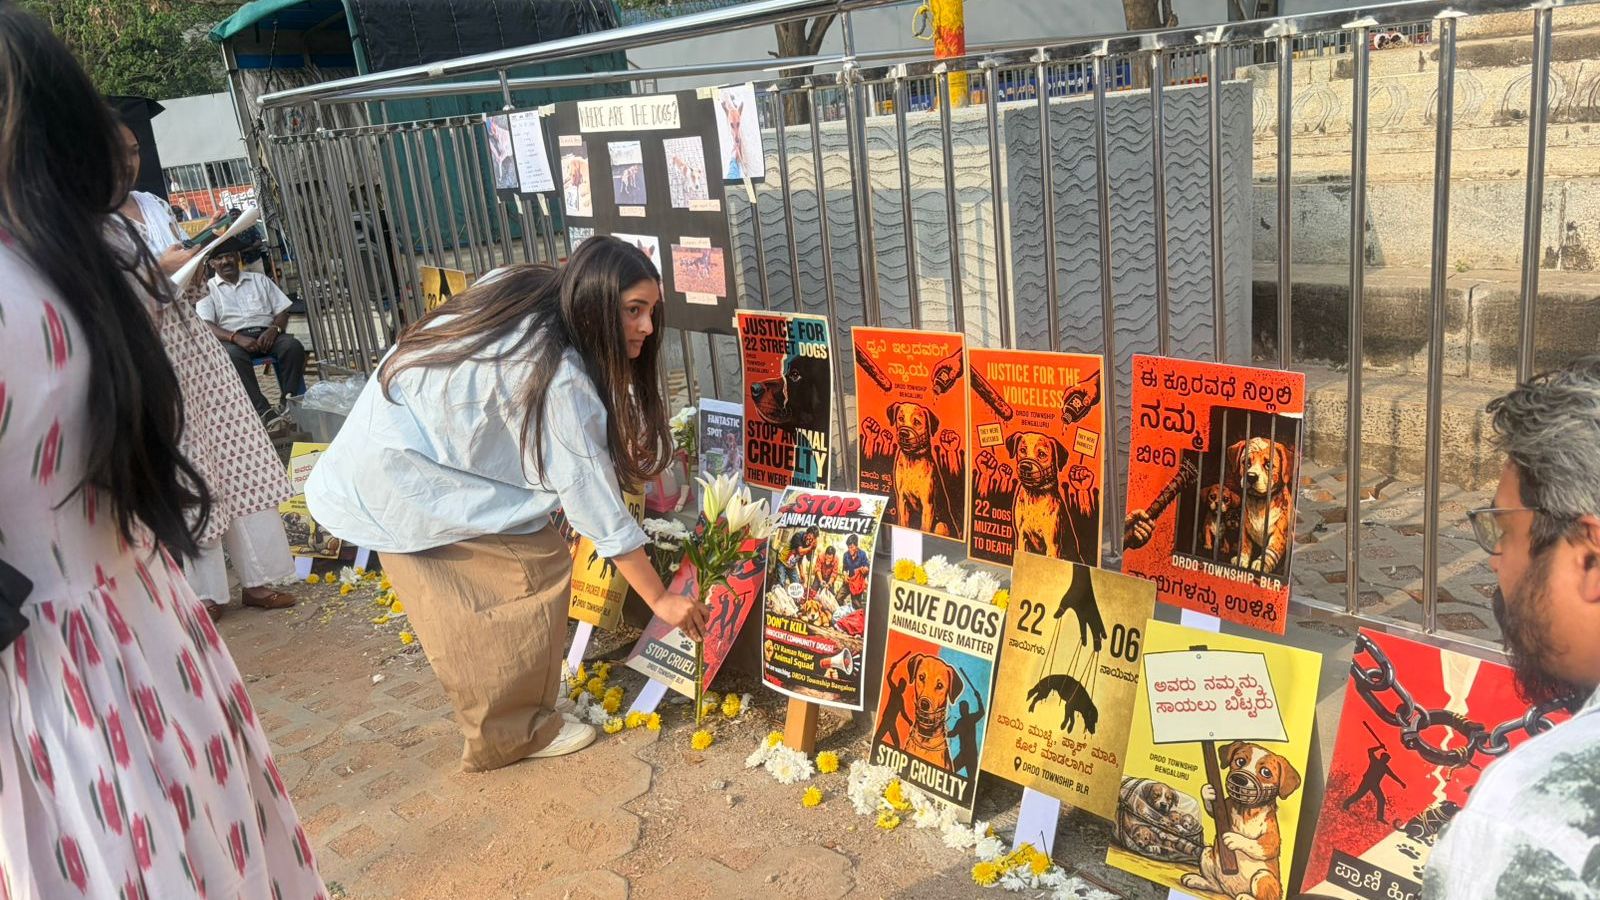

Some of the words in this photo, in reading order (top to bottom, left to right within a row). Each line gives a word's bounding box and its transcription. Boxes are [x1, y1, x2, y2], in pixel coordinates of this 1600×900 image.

[579, 105, 606, 128] WHERE
[608, 105, 625, 127] ARE
[631, 104, 649, 126] THE
[651, 101, 678, 125] DOGS?
[743, 317, 795, 339] JUSTICE
[798, 321, 825, 342] FOR
[745, 337, 758, 351] 22
[760, 338, 796, 355] STREET
[799, 341, 827, 359] DOGS
[987, 361, 1030, 383] JUSTICE
[1033, 364, 1055, 384] FOR
[1057, 367, 1081, 387] THE
[1141, 367, 1157, 387] ಈ
[1003, 384, 1064, 409] VOICELESS
[707, 427, 723, 437] SPOT
[708, 414, 741, 428] FANTASTIC
[1140, 399, 1204, 450] ನಮ್ಮ
[748, 419, 778, 440] STOP
[781, 427, 828, 452] ANIMAL
[747, 439, 828, 478] CRUELTY
[747, 467, 767, 482] THEY
[768, 472, 788, 487] WERE
[794, 493, 862, 517] STOP
[975, 498, 990, 517] 22
[992, 508, 1012, 521] DOGS
[780, 512, 817, 527] ANIMAL
[819, 515, 872, 534] CRUELTY!
[974, 519, 1013, 539] MUZZLED
[974, 536, 985, 551] TO
[986, 538, 1013, 556] DEATH
[1173, 554, 1199, 572] DRDO
[1260, 575, 1281, 592] BLR
[894, 586, 940, 622] SAVE
[942, 600, 999, 638] DOGS
[766, 614, 789, 630] DON'T
[790, 620, 809, 636] KILL
[891, 614, 928, 635] ANIMALS
[929, 624, 954, 643] LIVES
[956, 633, 994, 656] MATTER
[1017, 598, 1046, 636] 22
[1110, 622, 1141, 663] 06
[645, 642, 669, 661] STOP
[774, 643, 781, 651] CV
[798, 650, 815, 662] Nagar
[787, 633, 816, 649] COMMUNITY
[816, 642, 834, 653] DOGS!
[774, 652, 793, 665] Animal
[794, 658, 815, 671] Squad
[807, 676, 831, 689] Township
[1154, 677, 1196, 692] ಅವರು
[1156, 698, 1217, 713] ಸಾಯಲು
[1225, 695, 1274, 718] ಬಿಟ್ಟರು
[877, 743, 909, 774] STOP
[911, 758, 969, 802] CRUELTY
[1149, 752, 1166, 763] DRDO
[1166, 756, 1198, 771] TOWNSHIP
[1022, 761, 1040, 777] DRDO
[1041, 769, 1075, 791] TOWNSHIP,
[1075, 781, 1091, 796] BLR
[1154, 765, 1190, 781] BENGALURU
[1335, 861, 1381, 891] ಪ್ರಾಣಿ
